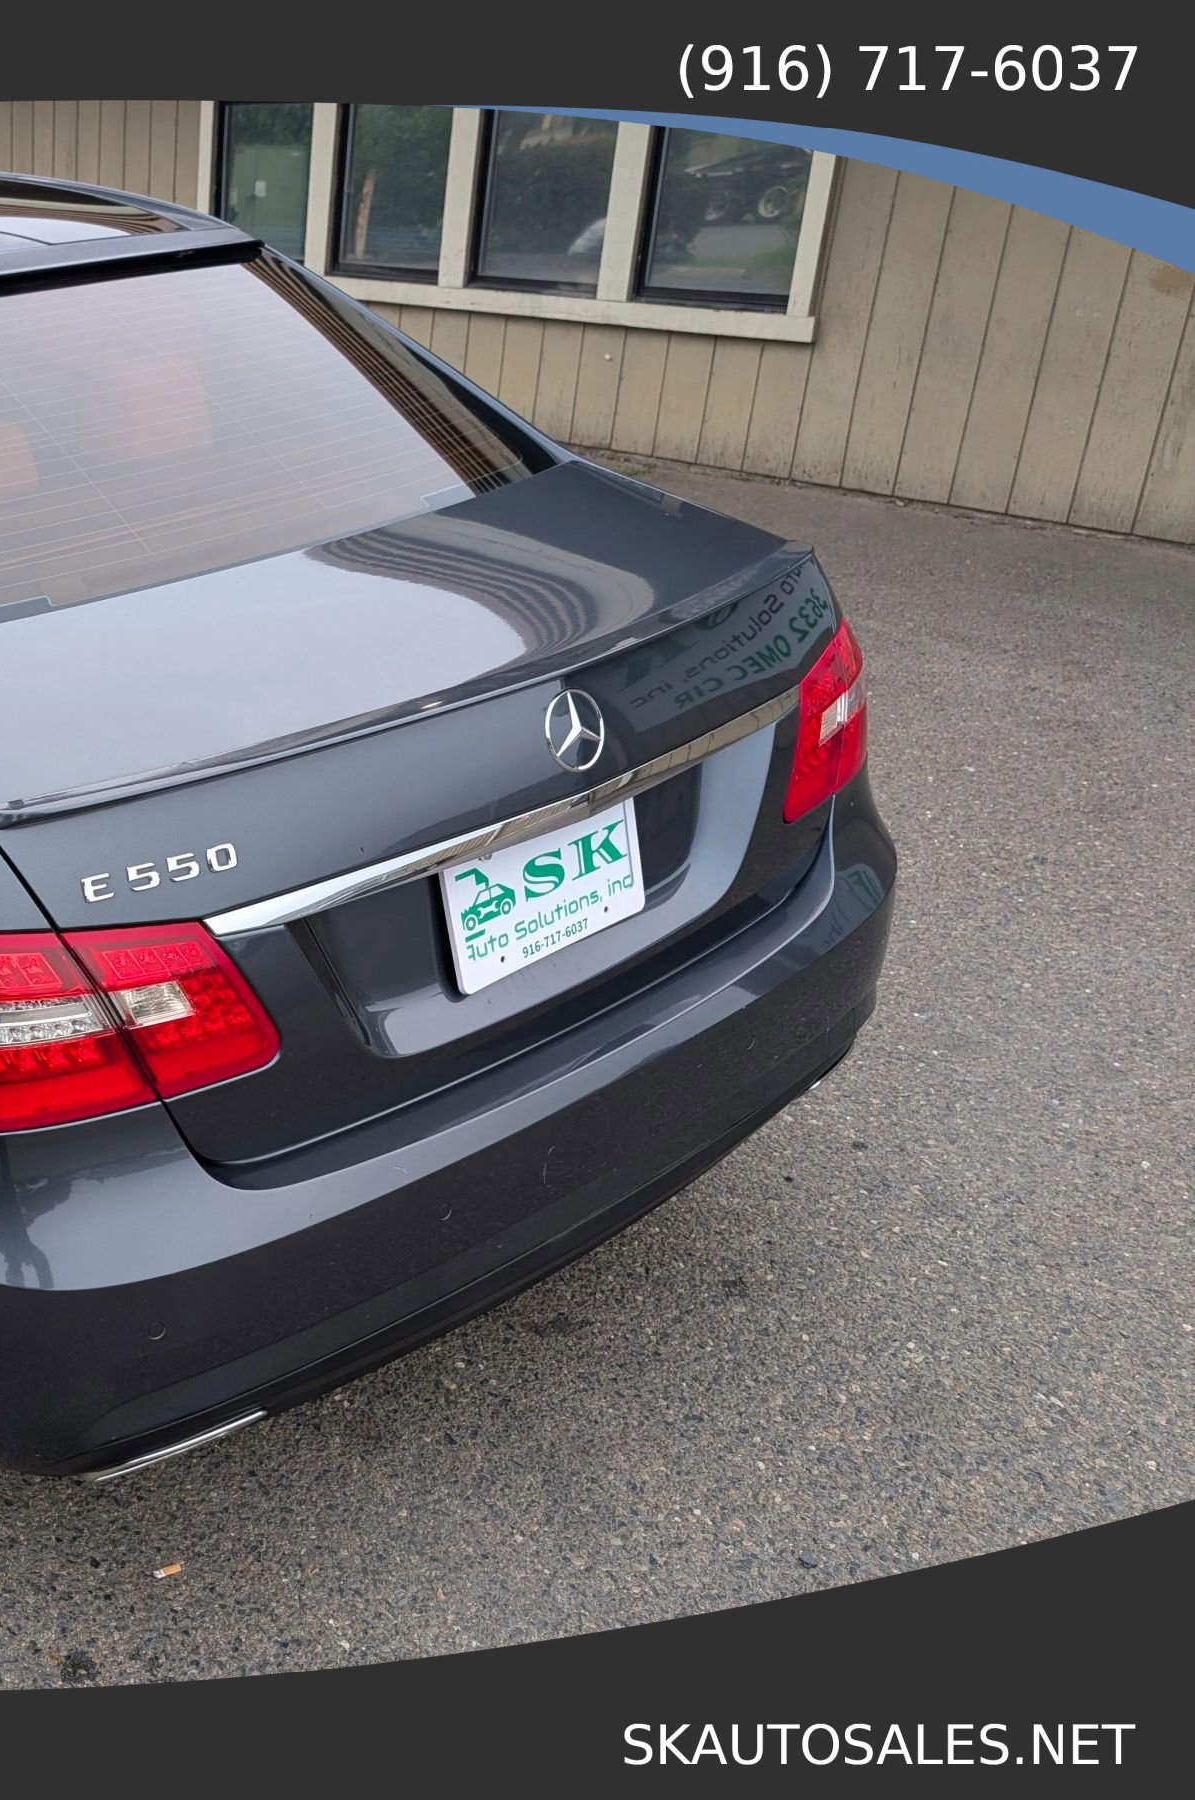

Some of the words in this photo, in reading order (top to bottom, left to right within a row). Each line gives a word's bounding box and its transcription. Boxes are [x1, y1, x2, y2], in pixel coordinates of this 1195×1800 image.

[81, 872, 116, 903] E
[126, 842, 238, 892] 550
[522, 819, 628, 901] SK
[514, 889, 603, 941] Solutions,
[522, 917, 589, 959] 916-717-6037
